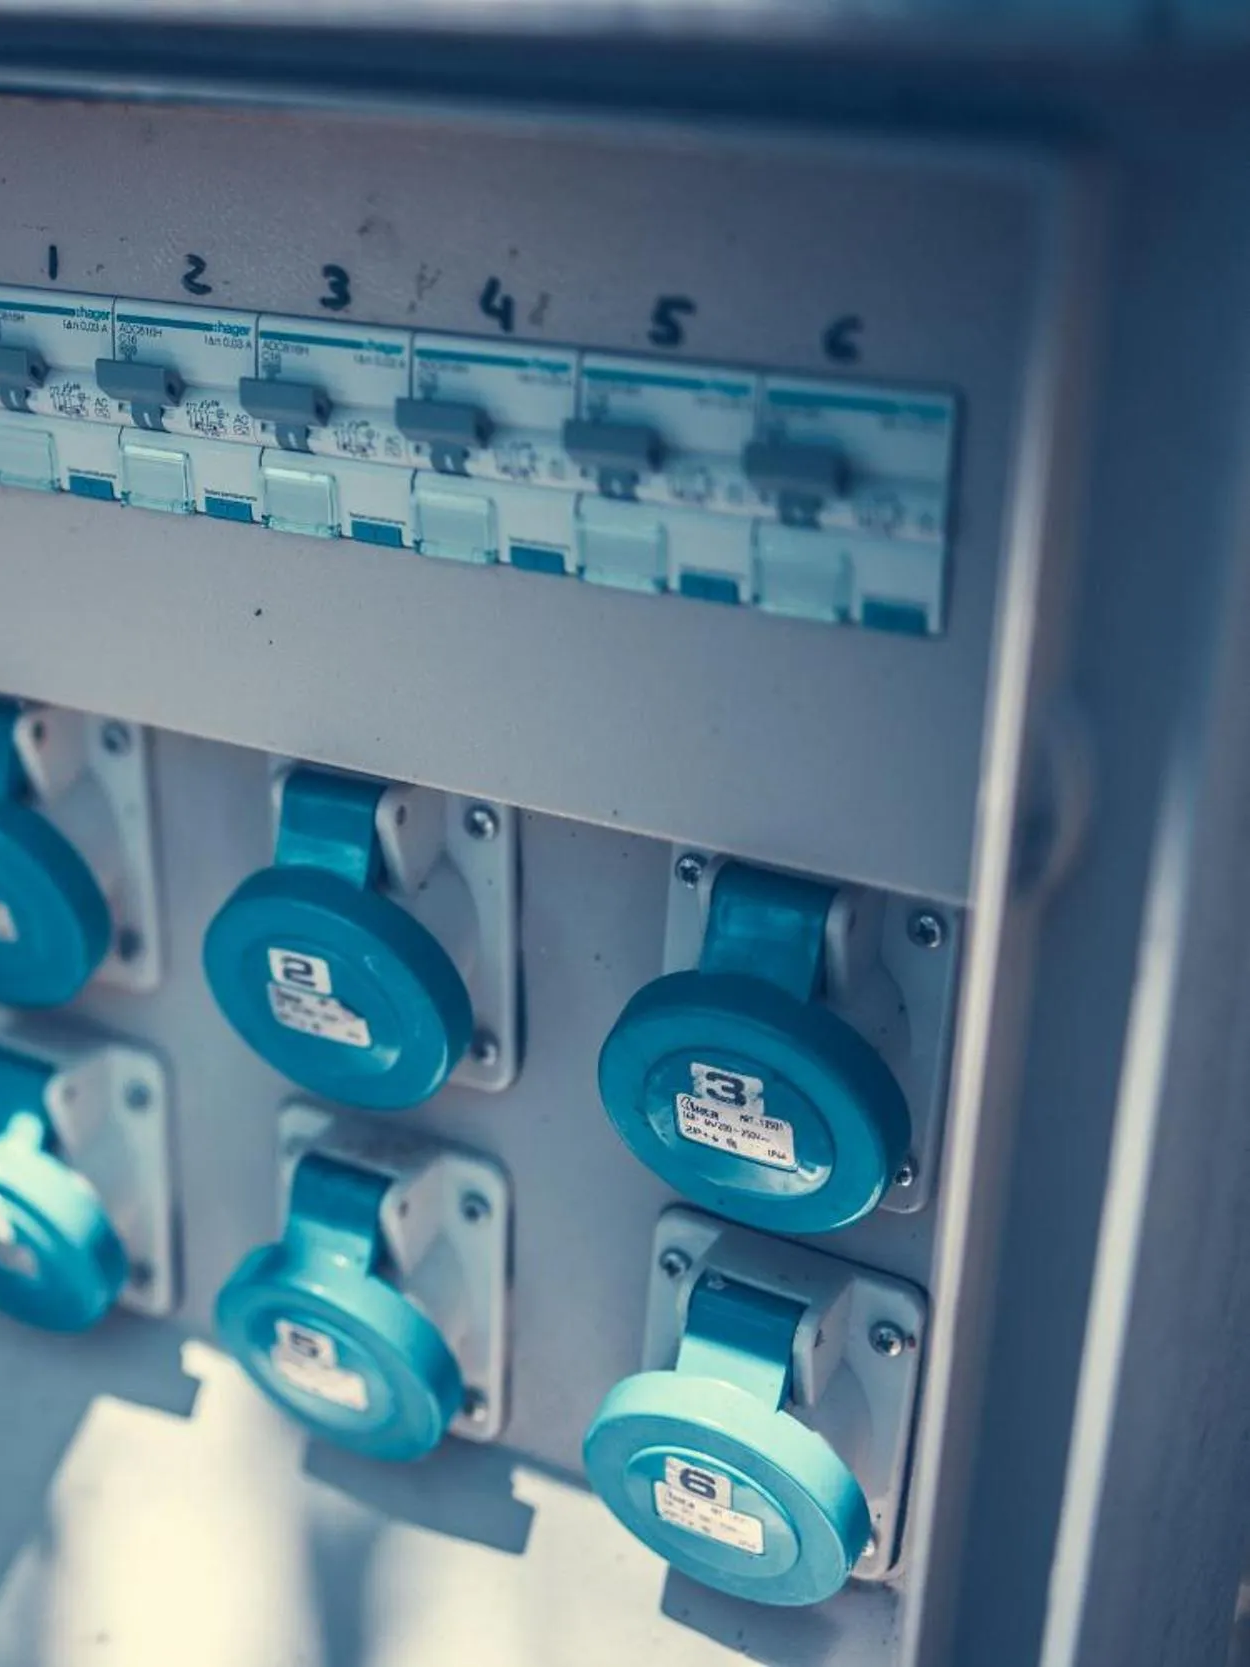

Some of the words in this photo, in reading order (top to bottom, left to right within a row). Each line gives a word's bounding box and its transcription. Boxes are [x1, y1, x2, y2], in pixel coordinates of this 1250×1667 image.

[50, 245, 59, 280] 1
[182, 253, 213, 295] 2
[320, 263, 351, 311] 3
[480, 276, 515, 333] 4
[647, 295, 696, 347] 5
[821, 314, 864, 363] 6
[281, 955, 317, 988] 2
[705, 1071, 748, 1107] 3
[679, 1466, 717, 1500] 6
